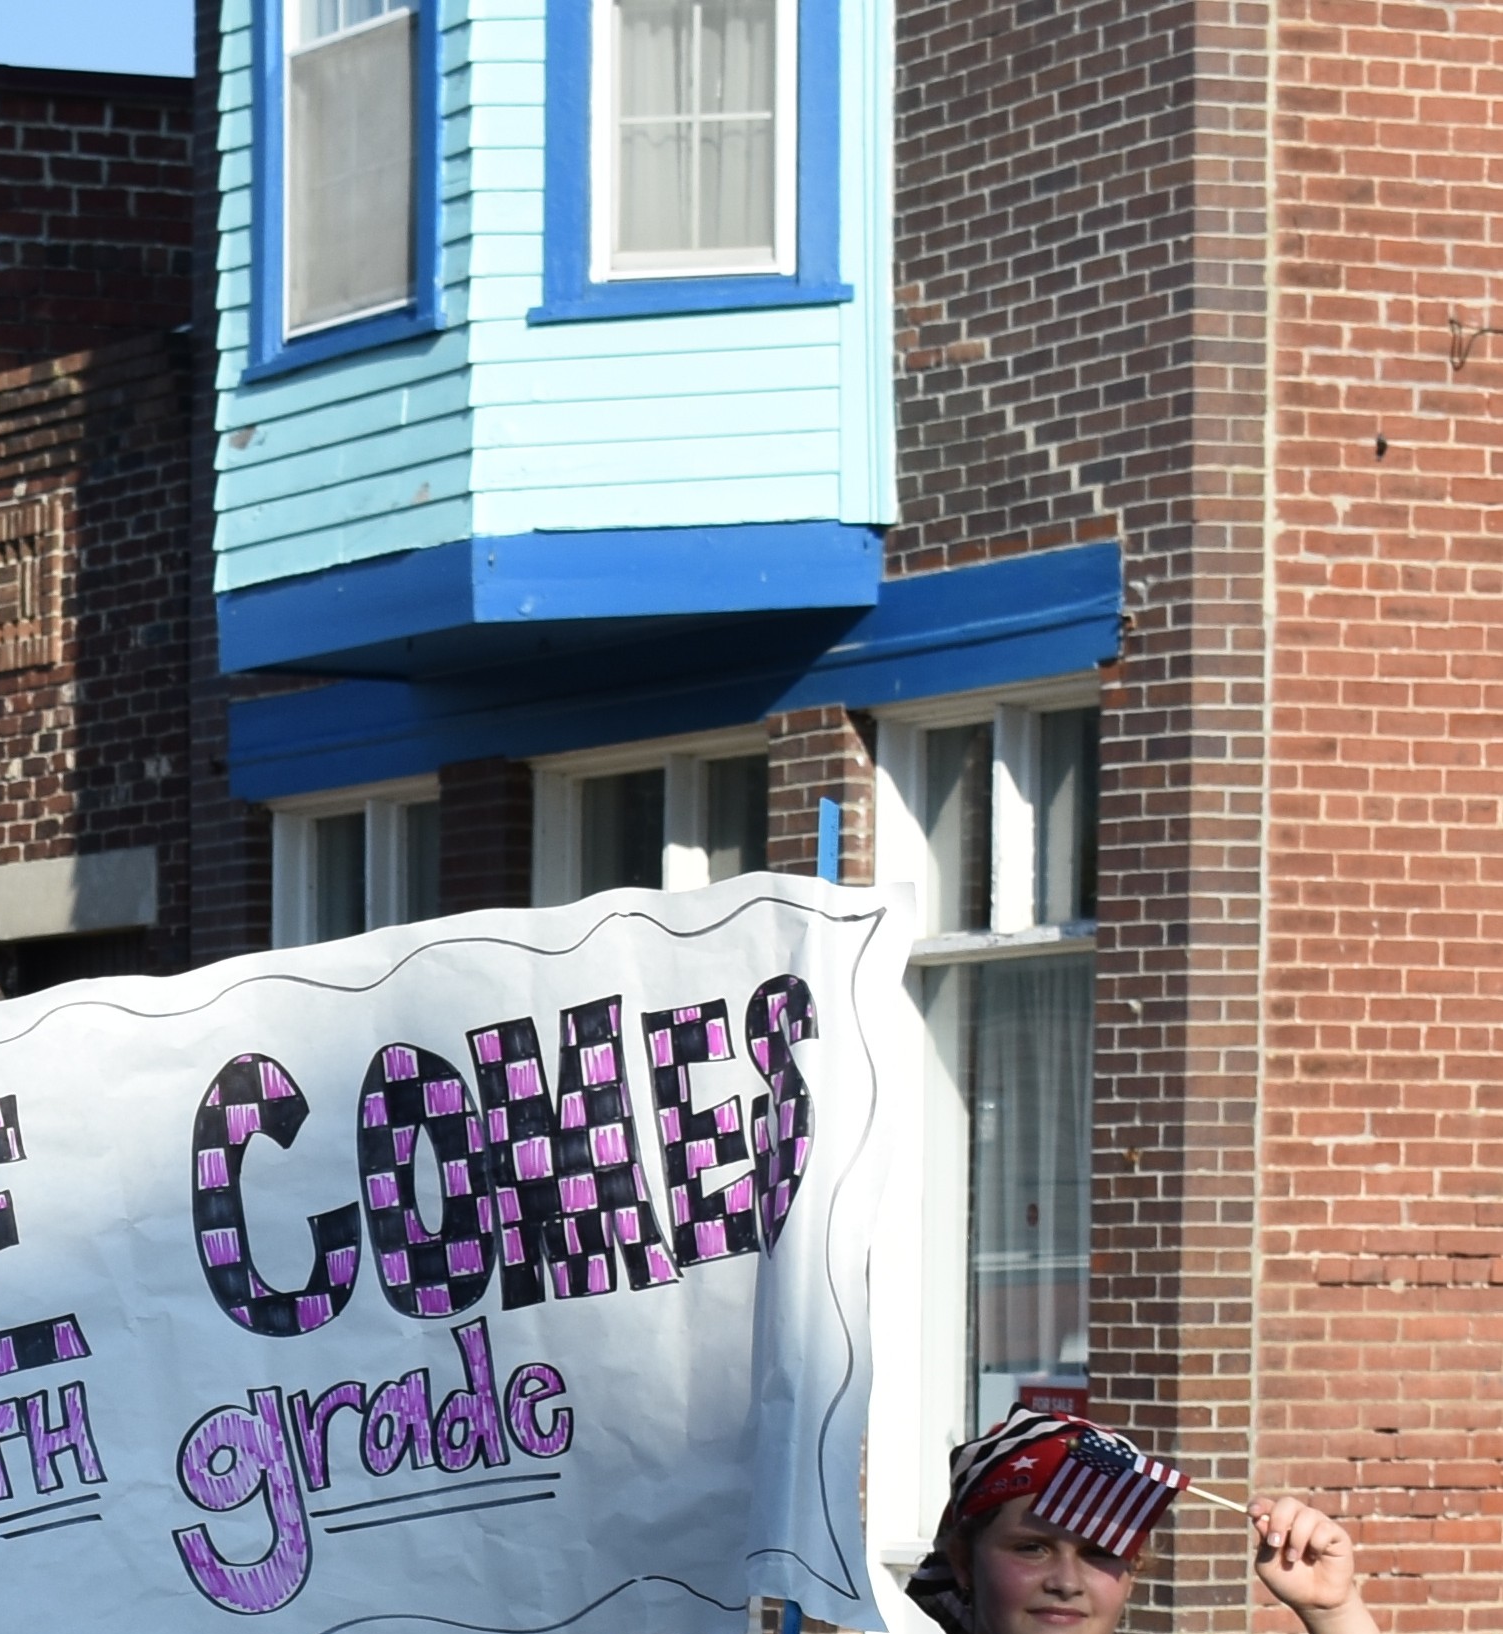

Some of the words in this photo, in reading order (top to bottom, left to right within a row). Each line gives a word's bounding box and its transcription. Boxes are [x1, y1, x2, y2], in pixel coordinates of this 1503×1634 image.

[191, 973, 819, 1338] COMES
[171, 1314, 575, 1615] grade
[1032, 1396, 1050, 1411] FOR
[1051, 1397, 1074, 1413] SALE
